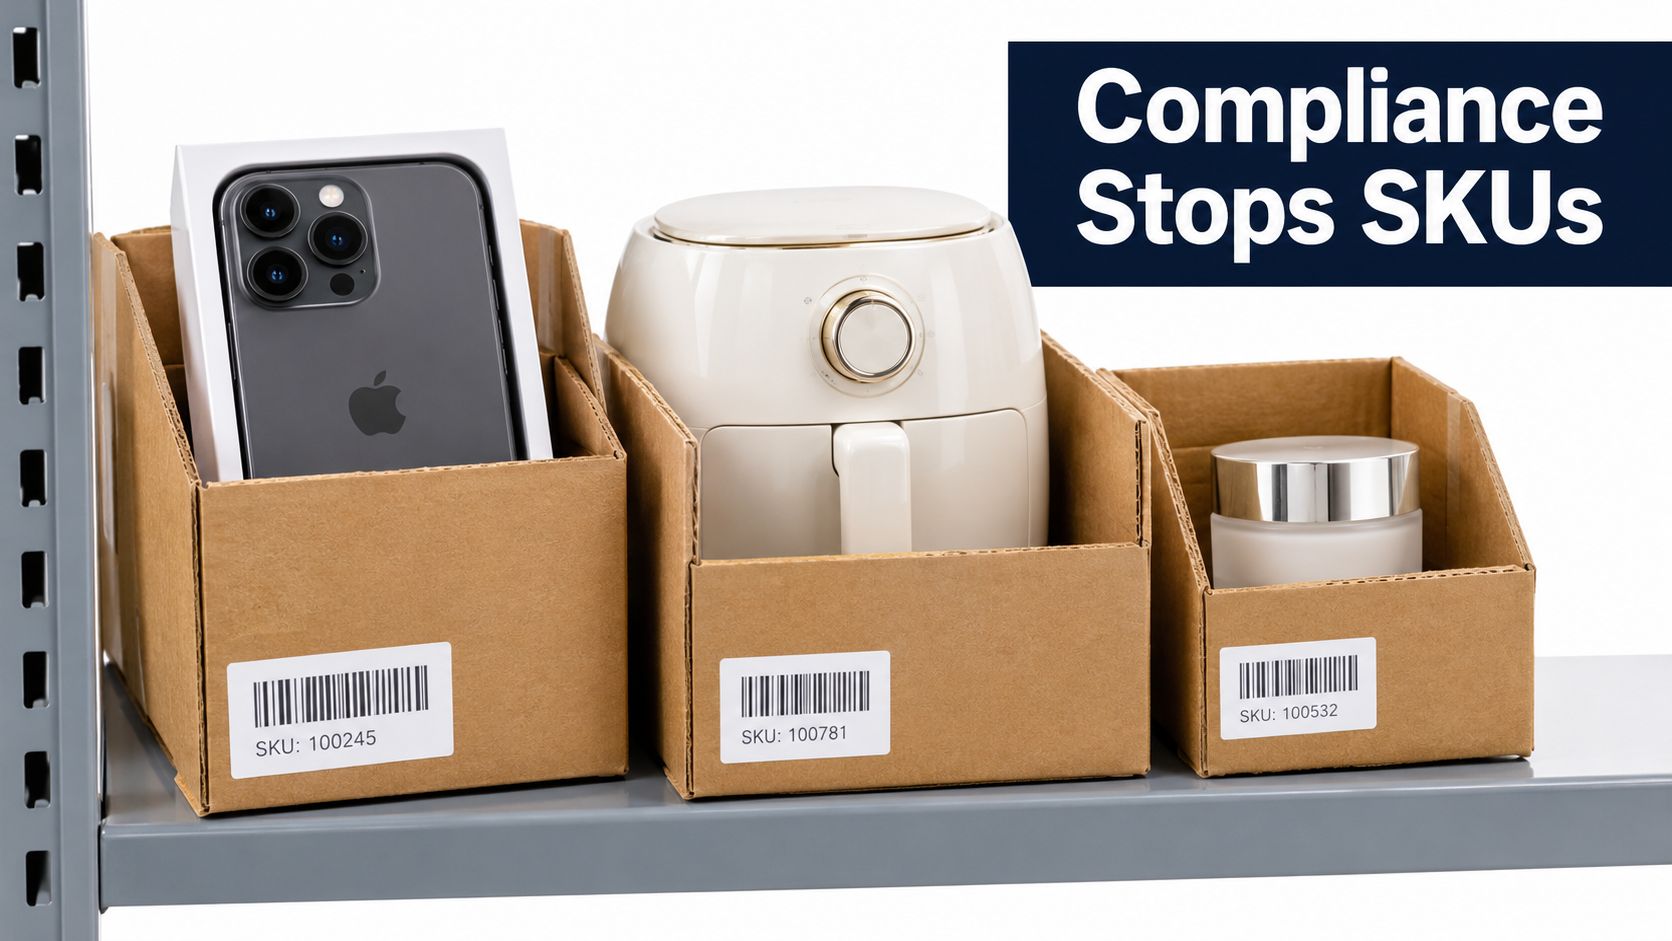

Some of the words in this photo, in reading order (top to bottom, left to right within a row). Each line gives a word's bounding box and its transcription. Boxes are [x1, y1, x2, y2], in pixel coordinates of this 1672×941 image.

[1240, 708, 1275, 723] SKU:
[1283, 703, 1338, 720] 100532
[256, 737, 300, 757] SKU:
[309, 730, 377, 751] 100245
[741, 728, 781, 745] SKU:
[789, 725, 847, 742] 100781
